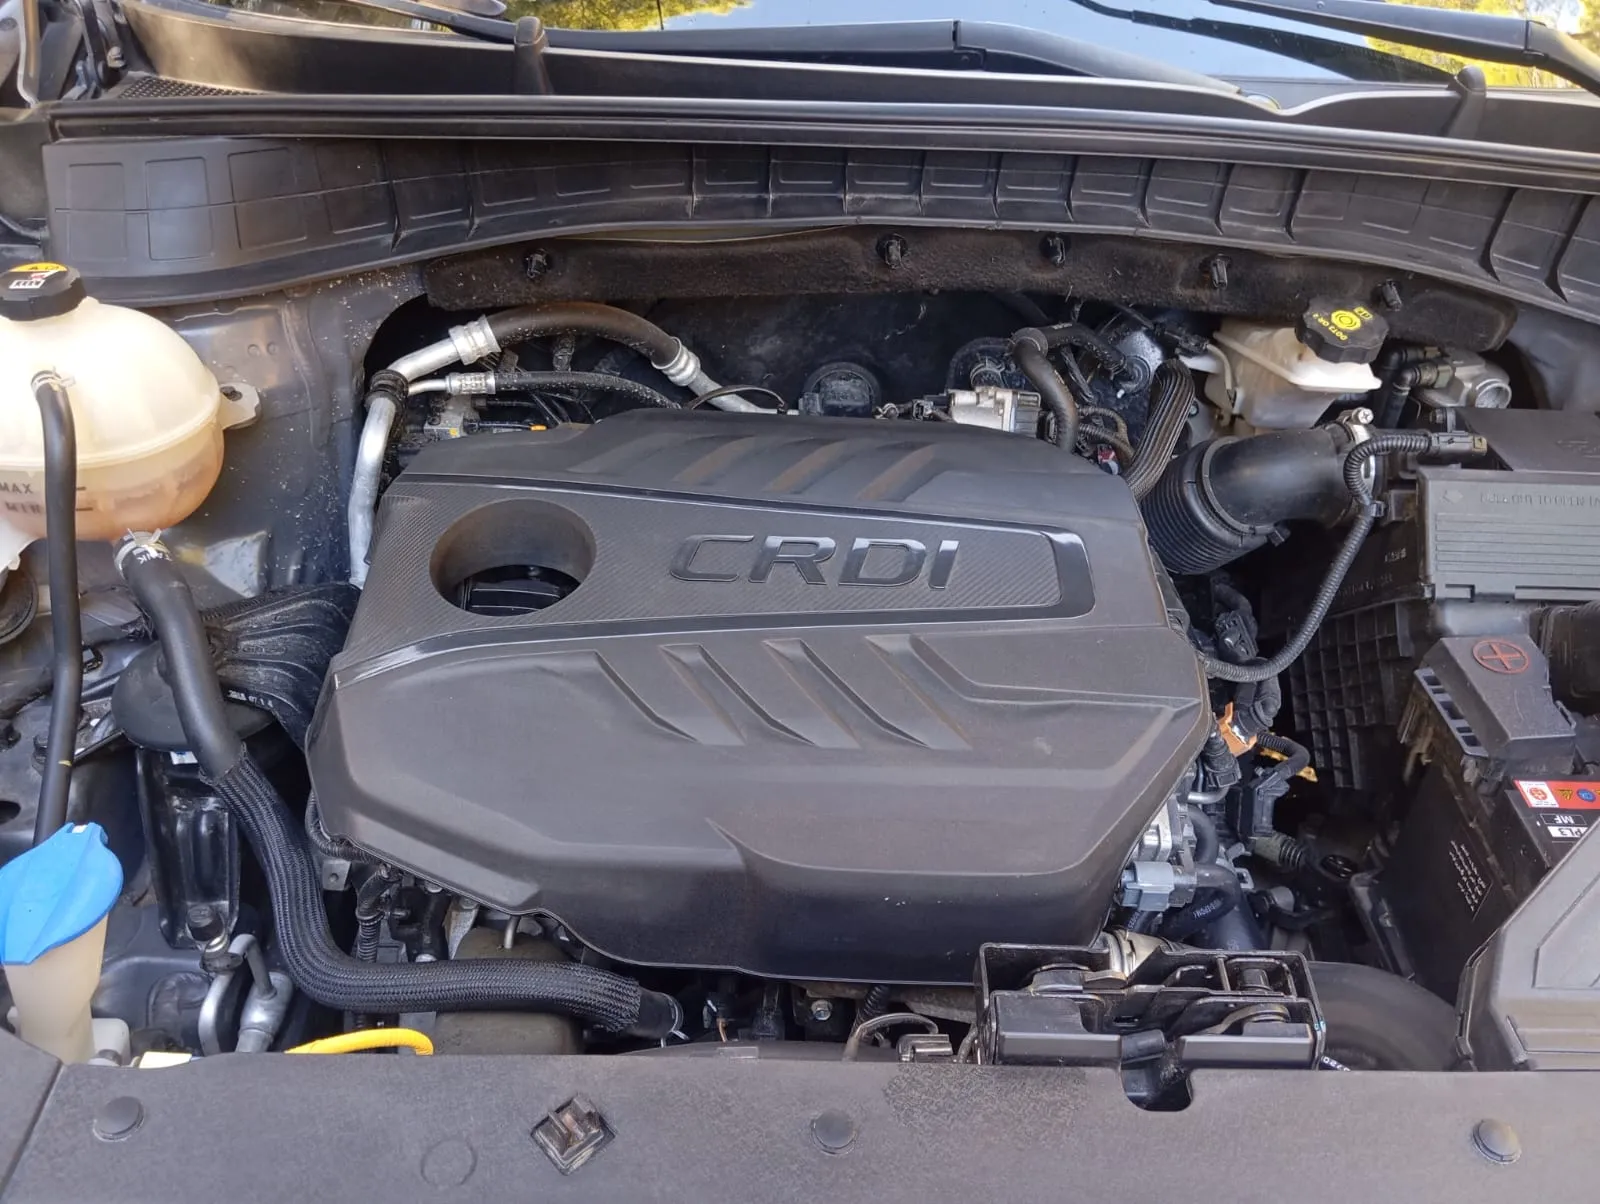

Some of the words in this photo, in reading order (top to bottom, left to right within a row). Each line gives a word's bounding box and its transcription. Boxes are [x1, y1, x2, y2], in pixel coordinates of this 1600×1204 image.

[0, 481, 33, 494] MAX
[670, 535, 959, 590] CRDI
[1553, 815, 1575, 824] MF
